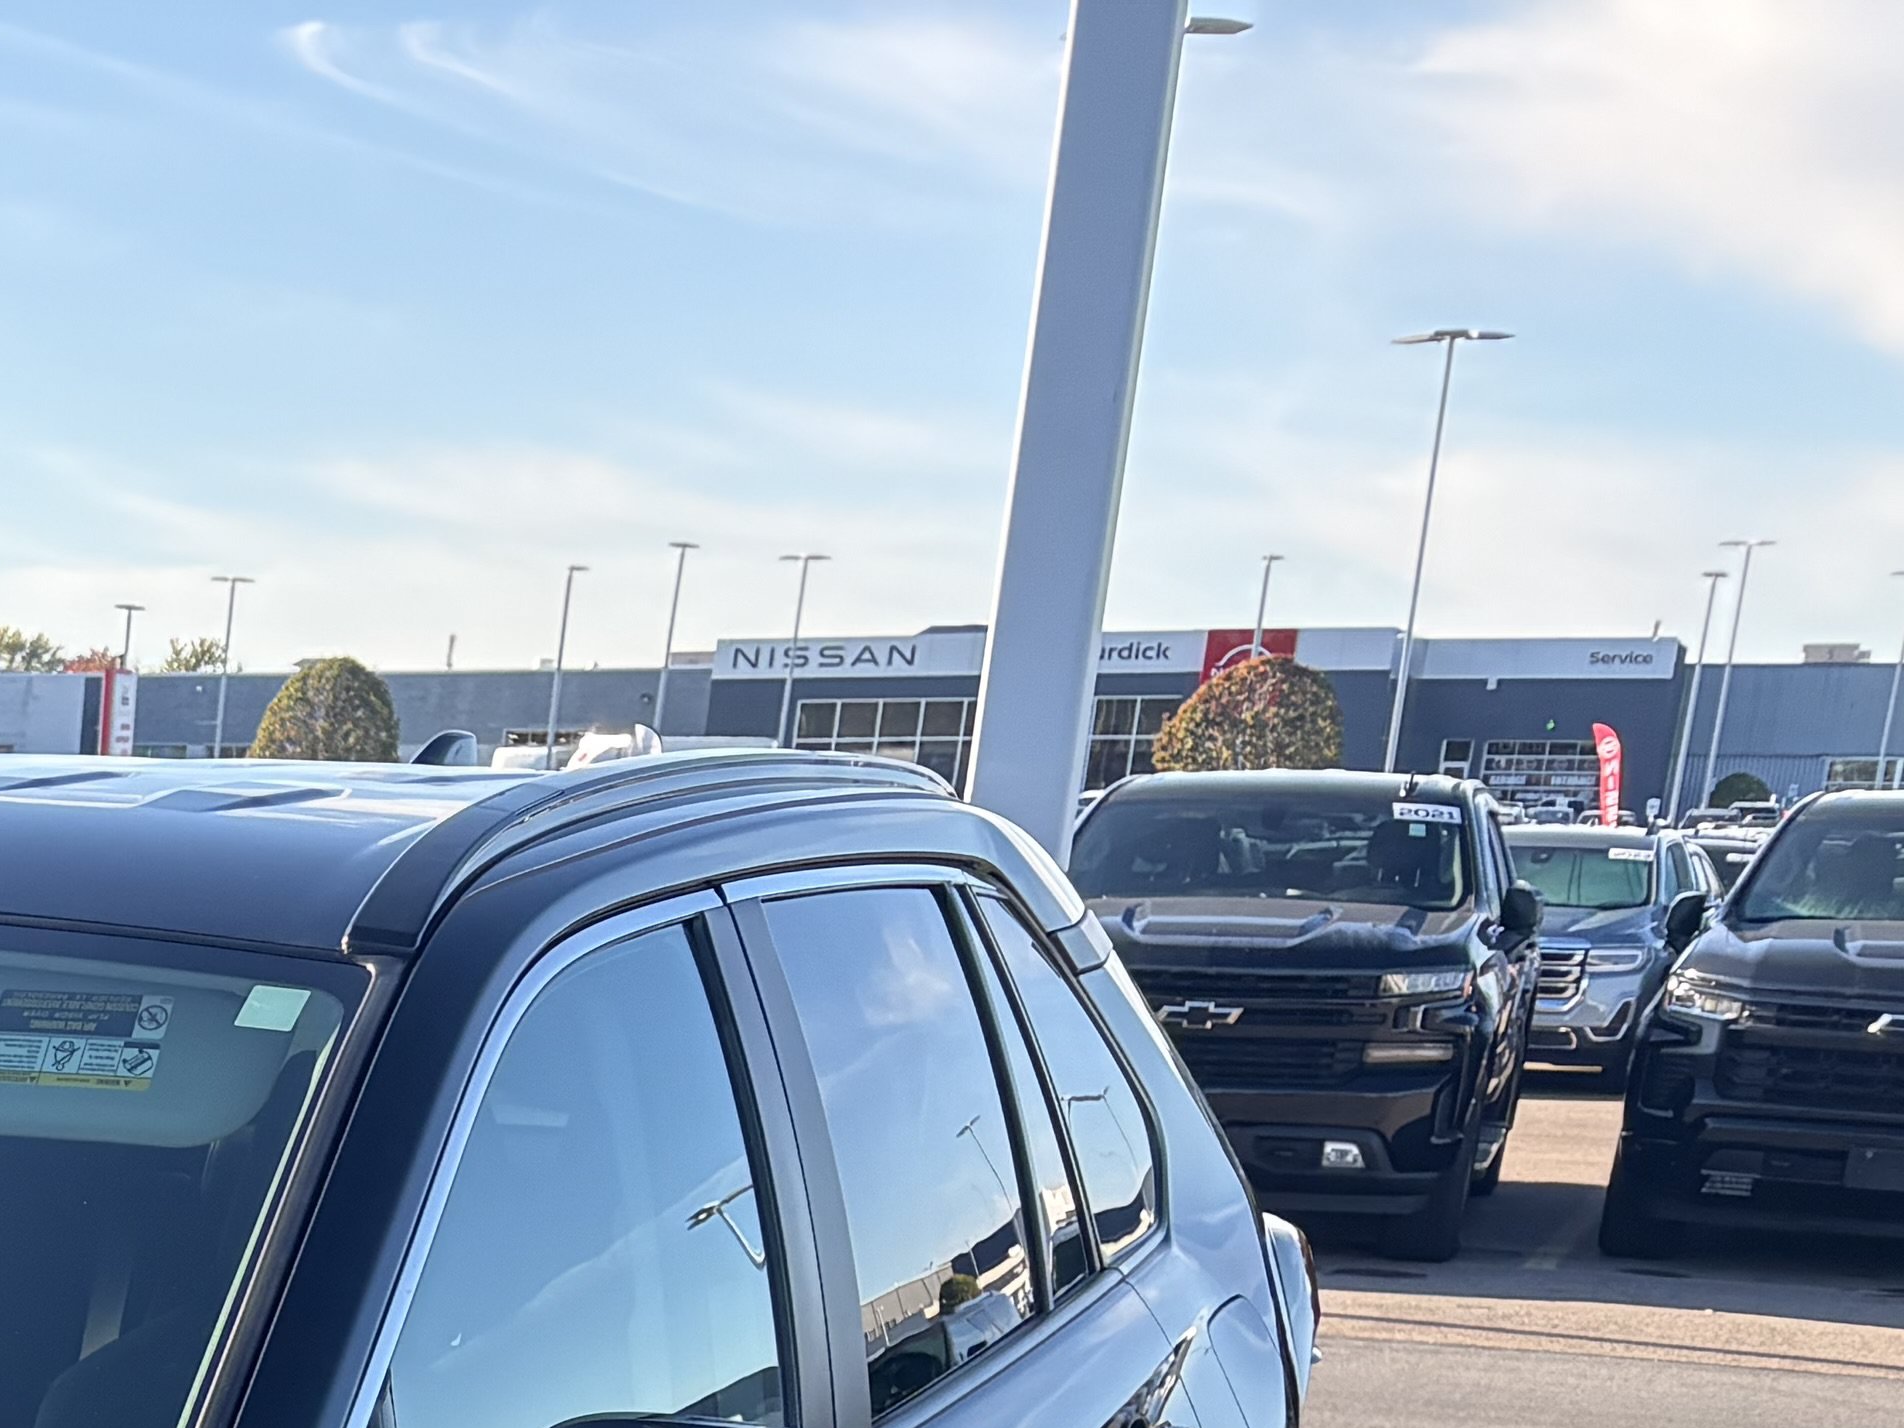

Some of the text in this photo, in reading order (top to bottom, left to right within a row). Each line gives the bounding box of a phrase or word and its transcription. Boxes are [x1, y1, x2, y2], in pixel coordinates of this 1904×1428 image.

[732, 643, 918, 669] NISSAN
[1589, 650, 1654, 665] Service
[1398, 807, 1459, 820] 2021
